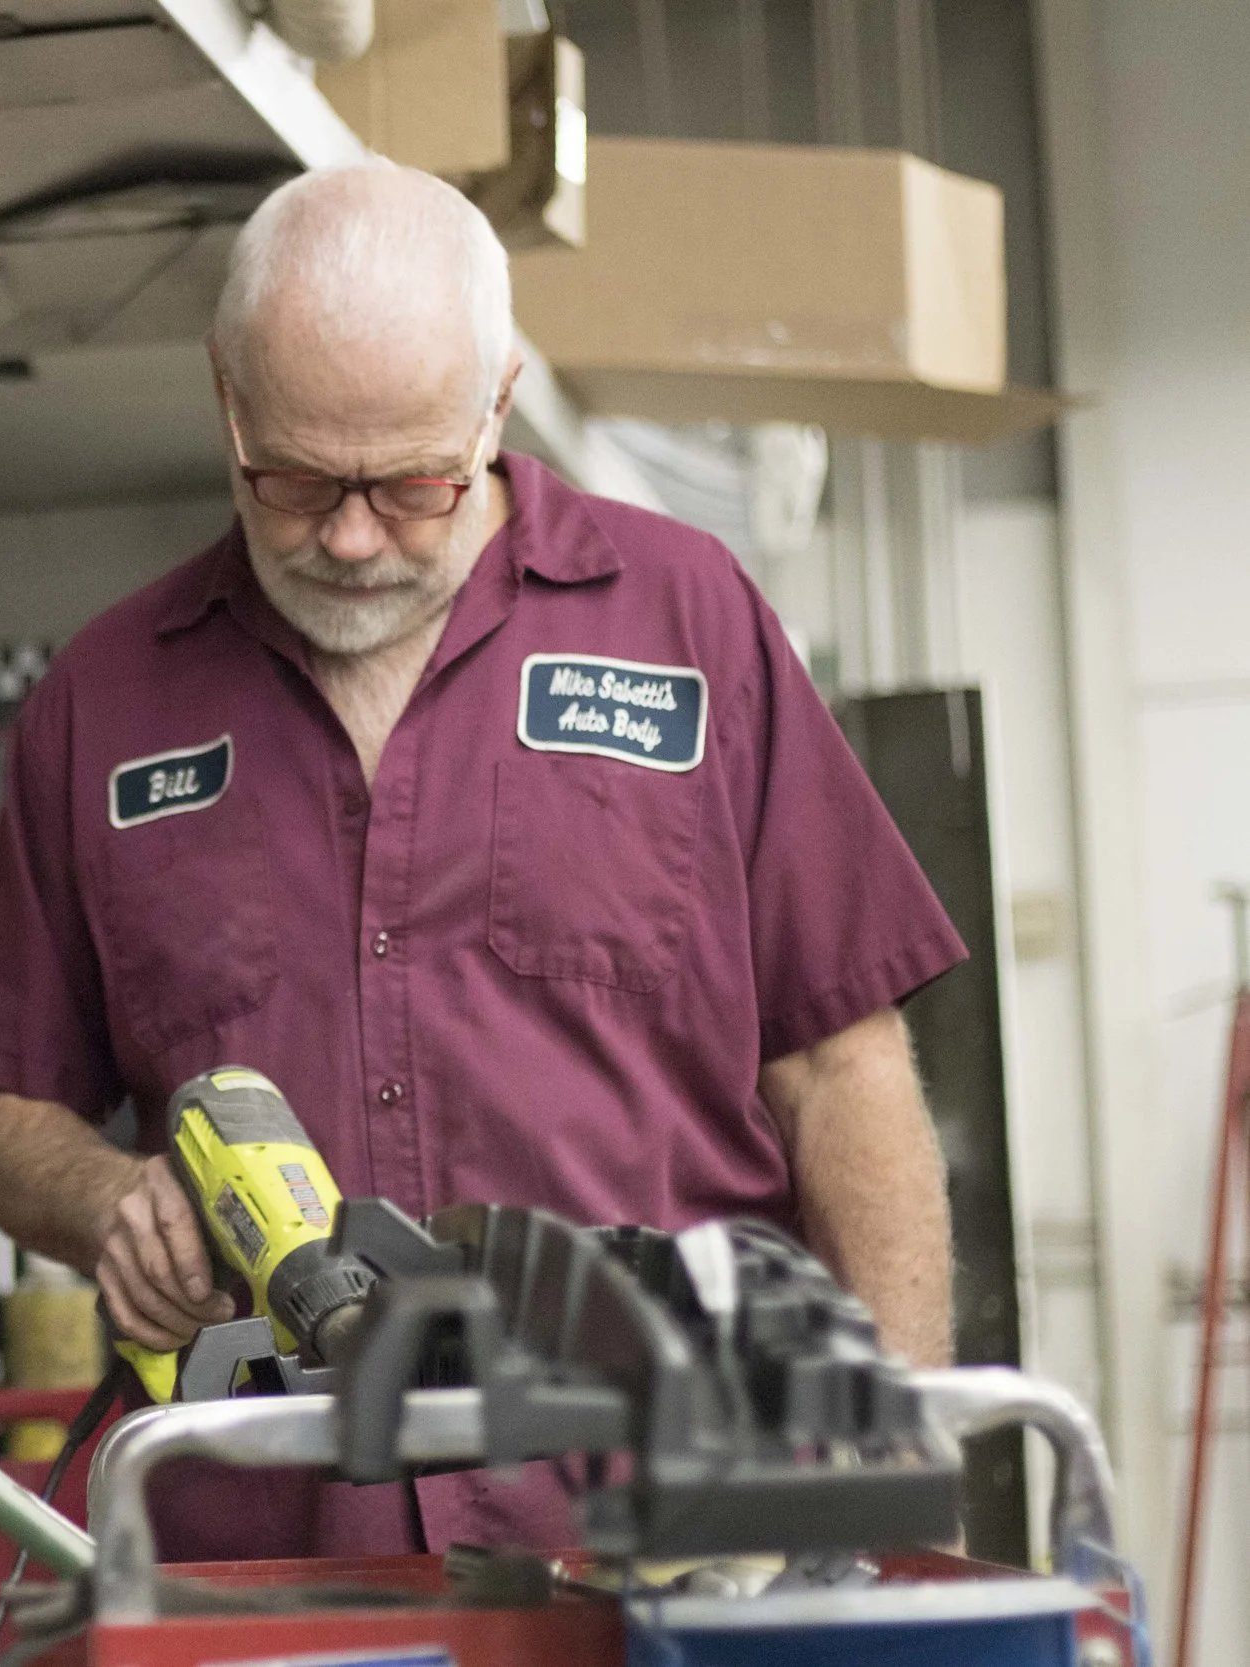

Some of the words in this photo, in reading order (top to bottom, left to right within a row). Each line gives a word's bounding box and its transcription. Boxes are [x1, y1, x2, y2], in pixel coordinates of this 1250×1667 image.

[549, 666, 595, 697] Mike
[558, 701, 610, 732] Auto
[612, 708, 662, 752] Body
[148, 765, 202, 803] Bill
